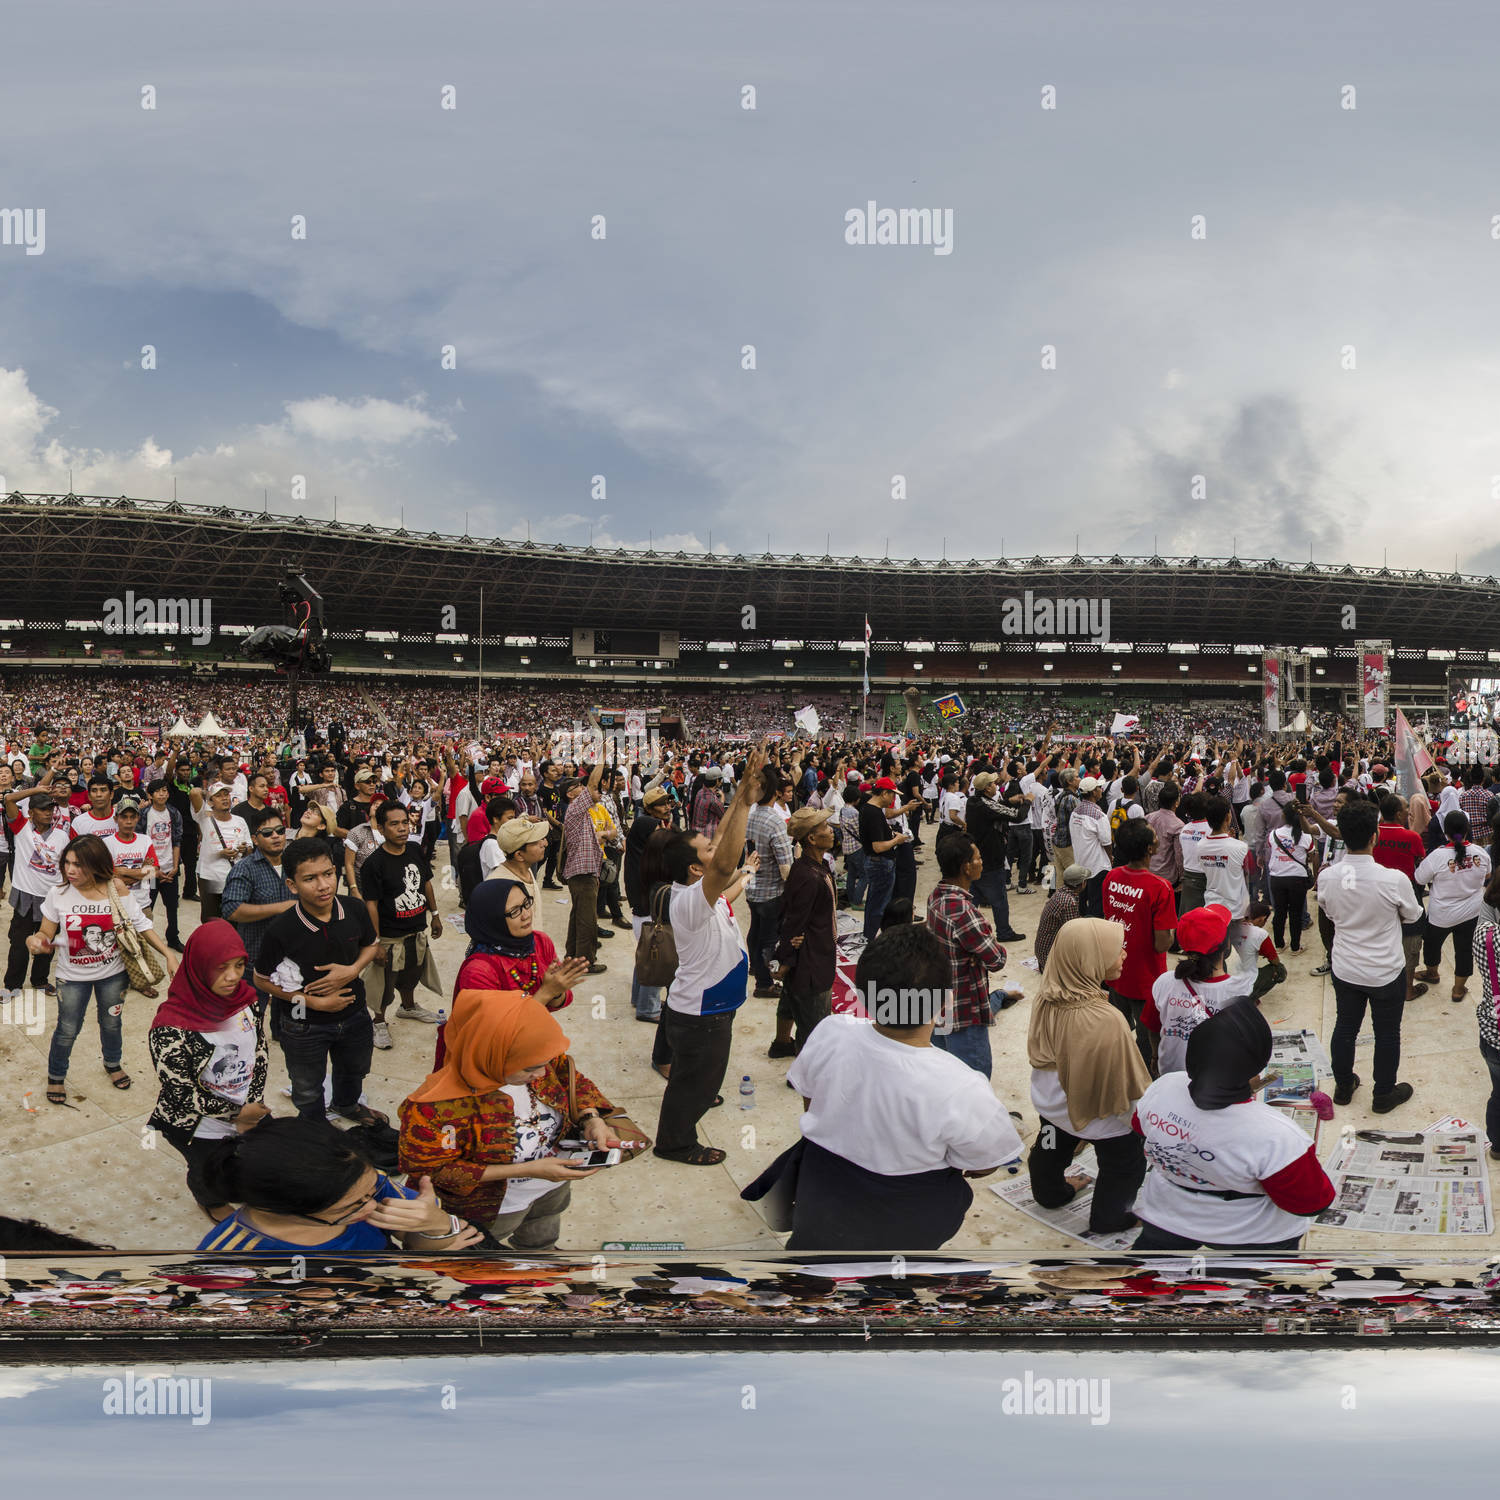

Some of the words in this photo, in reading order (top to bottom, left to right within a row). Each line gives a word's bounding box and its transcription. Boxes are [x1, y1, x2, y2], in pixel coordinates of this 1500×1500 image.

[72, 904, 112, 914] COBLO
[67, 915, 83, 931] 2
[237, 1060, 247, 1075] 2
